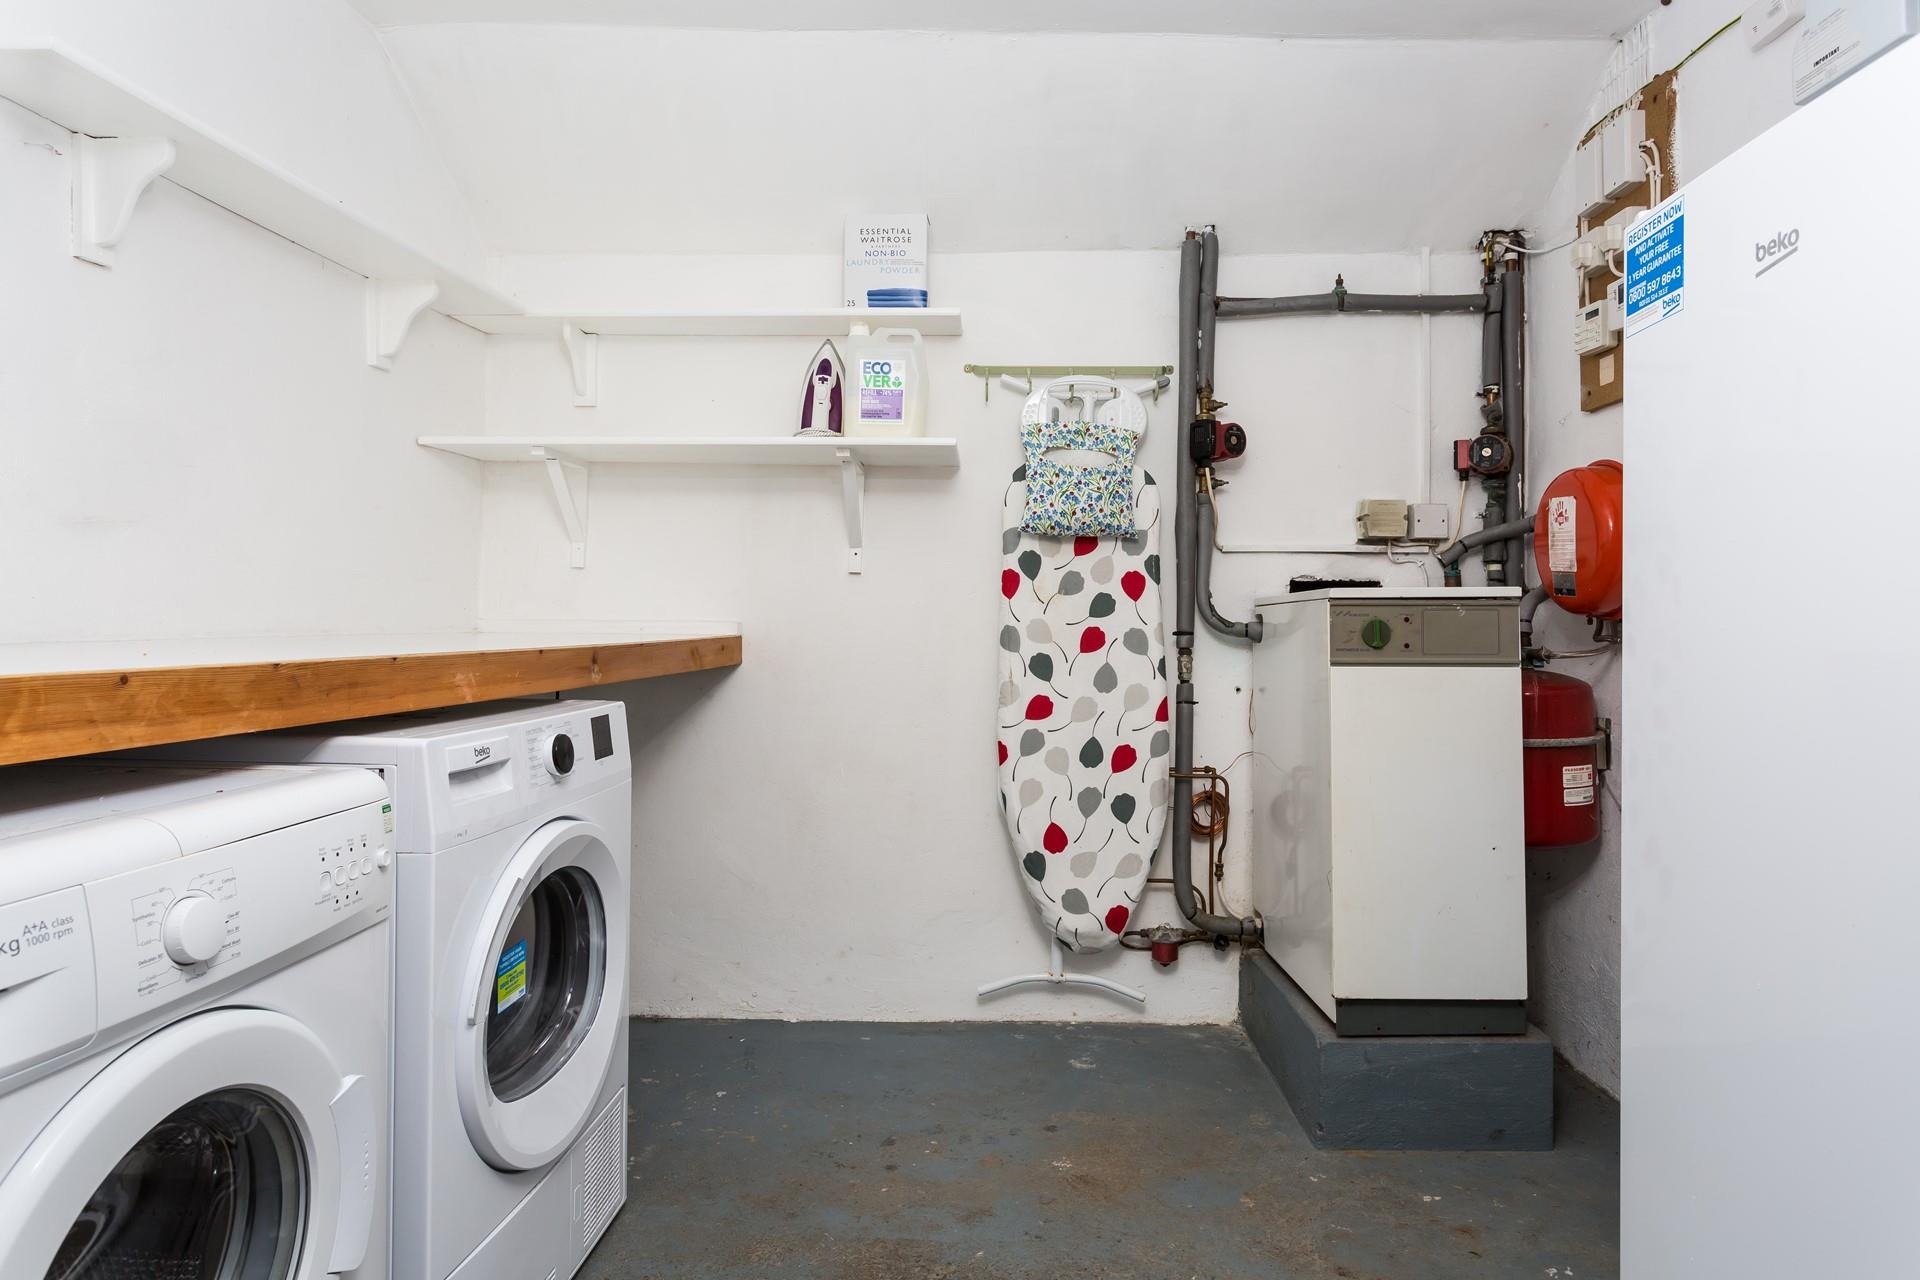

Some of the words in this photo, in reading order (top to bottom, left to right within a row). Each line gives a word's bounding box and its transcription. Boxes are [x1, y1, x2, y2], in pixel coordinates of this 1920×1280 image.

[1813, 46, 1840, 68] IMPORTANT
[860, 227, 912, 235] ESSENTIAL
[1628, 215, 1662, 246] REGISTER
[1663, 201, 1682, 222] NOW
[1635, 241, 1646, 256] AND
[1647, 223, 1674, 248] ACTIVATE
[1755, 228, 1800, 262] beko
[865, 249, 907, 257] NON-BIO
[1639, 250, 1654, 265] YOUR
[1654, 239, 1670, 256] FREE
[1632, 266, 1647, 280] YEAR
[1647, 244, 1682, 273] GUARANTEE
[1628, 286, 1646, 304] 0800
[1647, 277, 1661, 294] 597
[1661, 265, 1682, 285] 8643
[847, 299, 856, 307] 25
[1662, 293, 1681, 309] beko
[863, 361, 892, 375] ECO
[863, 375, 892, 388] VER
[473, 745, 491, 757] beko
[51, 915, 74, 928] class
[26, 932, 50, 947] 1000
[52, 927, 73, 940] rpm
